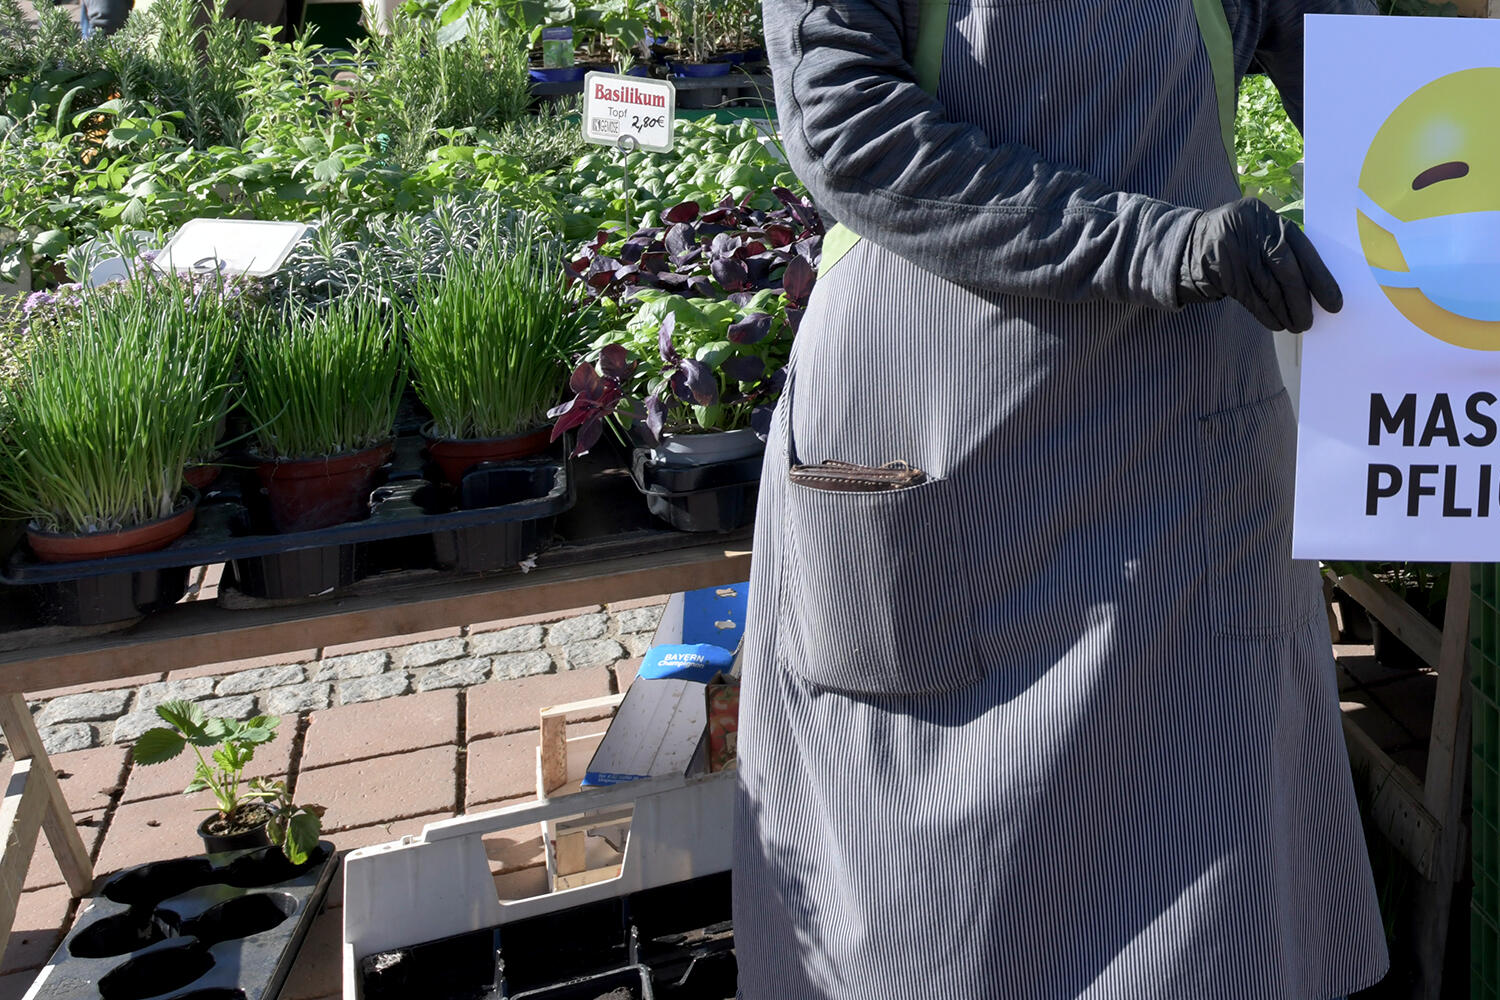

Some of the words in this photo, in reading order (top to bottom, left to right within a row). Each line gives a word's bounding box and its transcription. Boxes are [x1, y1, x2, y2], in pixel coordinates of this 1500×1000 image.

[595, 83, 665, 108] Basilikum
[608, 107, 628, 118] Topf
[632, 115, 665, 133] 2,80€
[664, 653, 705, 662] BAYERN
